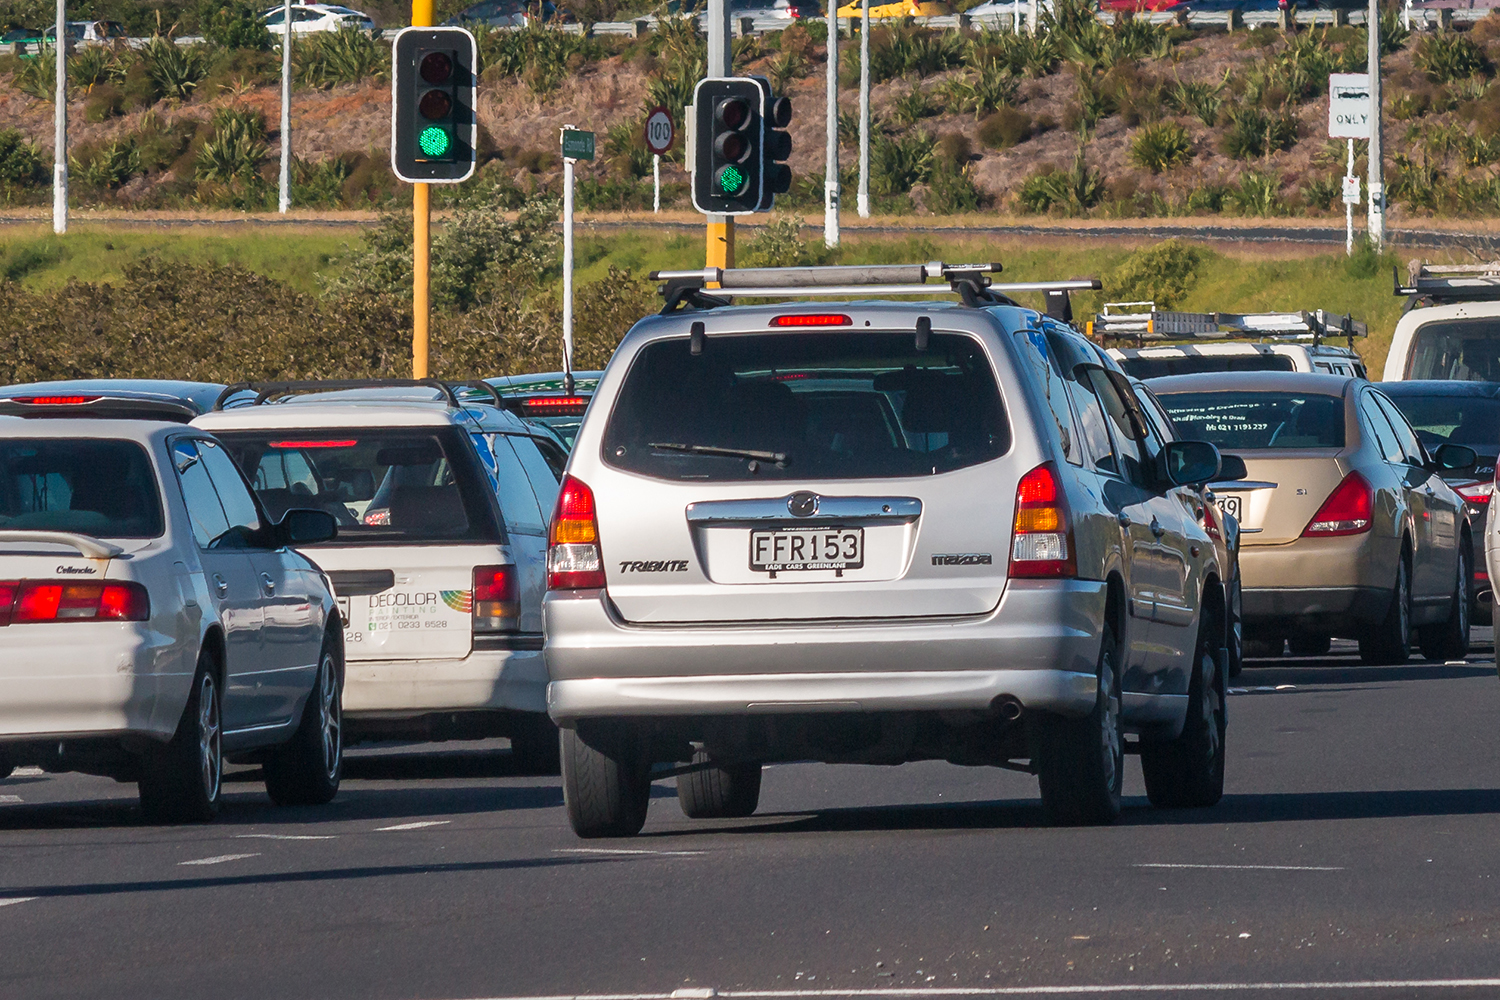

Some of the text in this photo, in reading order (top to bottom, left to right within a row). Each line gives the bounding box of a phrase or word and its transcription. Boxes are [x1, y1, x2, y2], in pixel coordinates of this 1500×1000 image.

[1336, 114, 1368, 125] ONLY
[650, 122, 670, 140] 100
[756, 534, 858, 561] FFR153
[619, 559, 689, 573] TRIBUTE
[369, 592, 437, 608] DECOLOR
[369, 606, 437, 616] PAINTING
[378, 620, 447, 630] 021 0233 6528
[345, 632, 363, 642] 28
